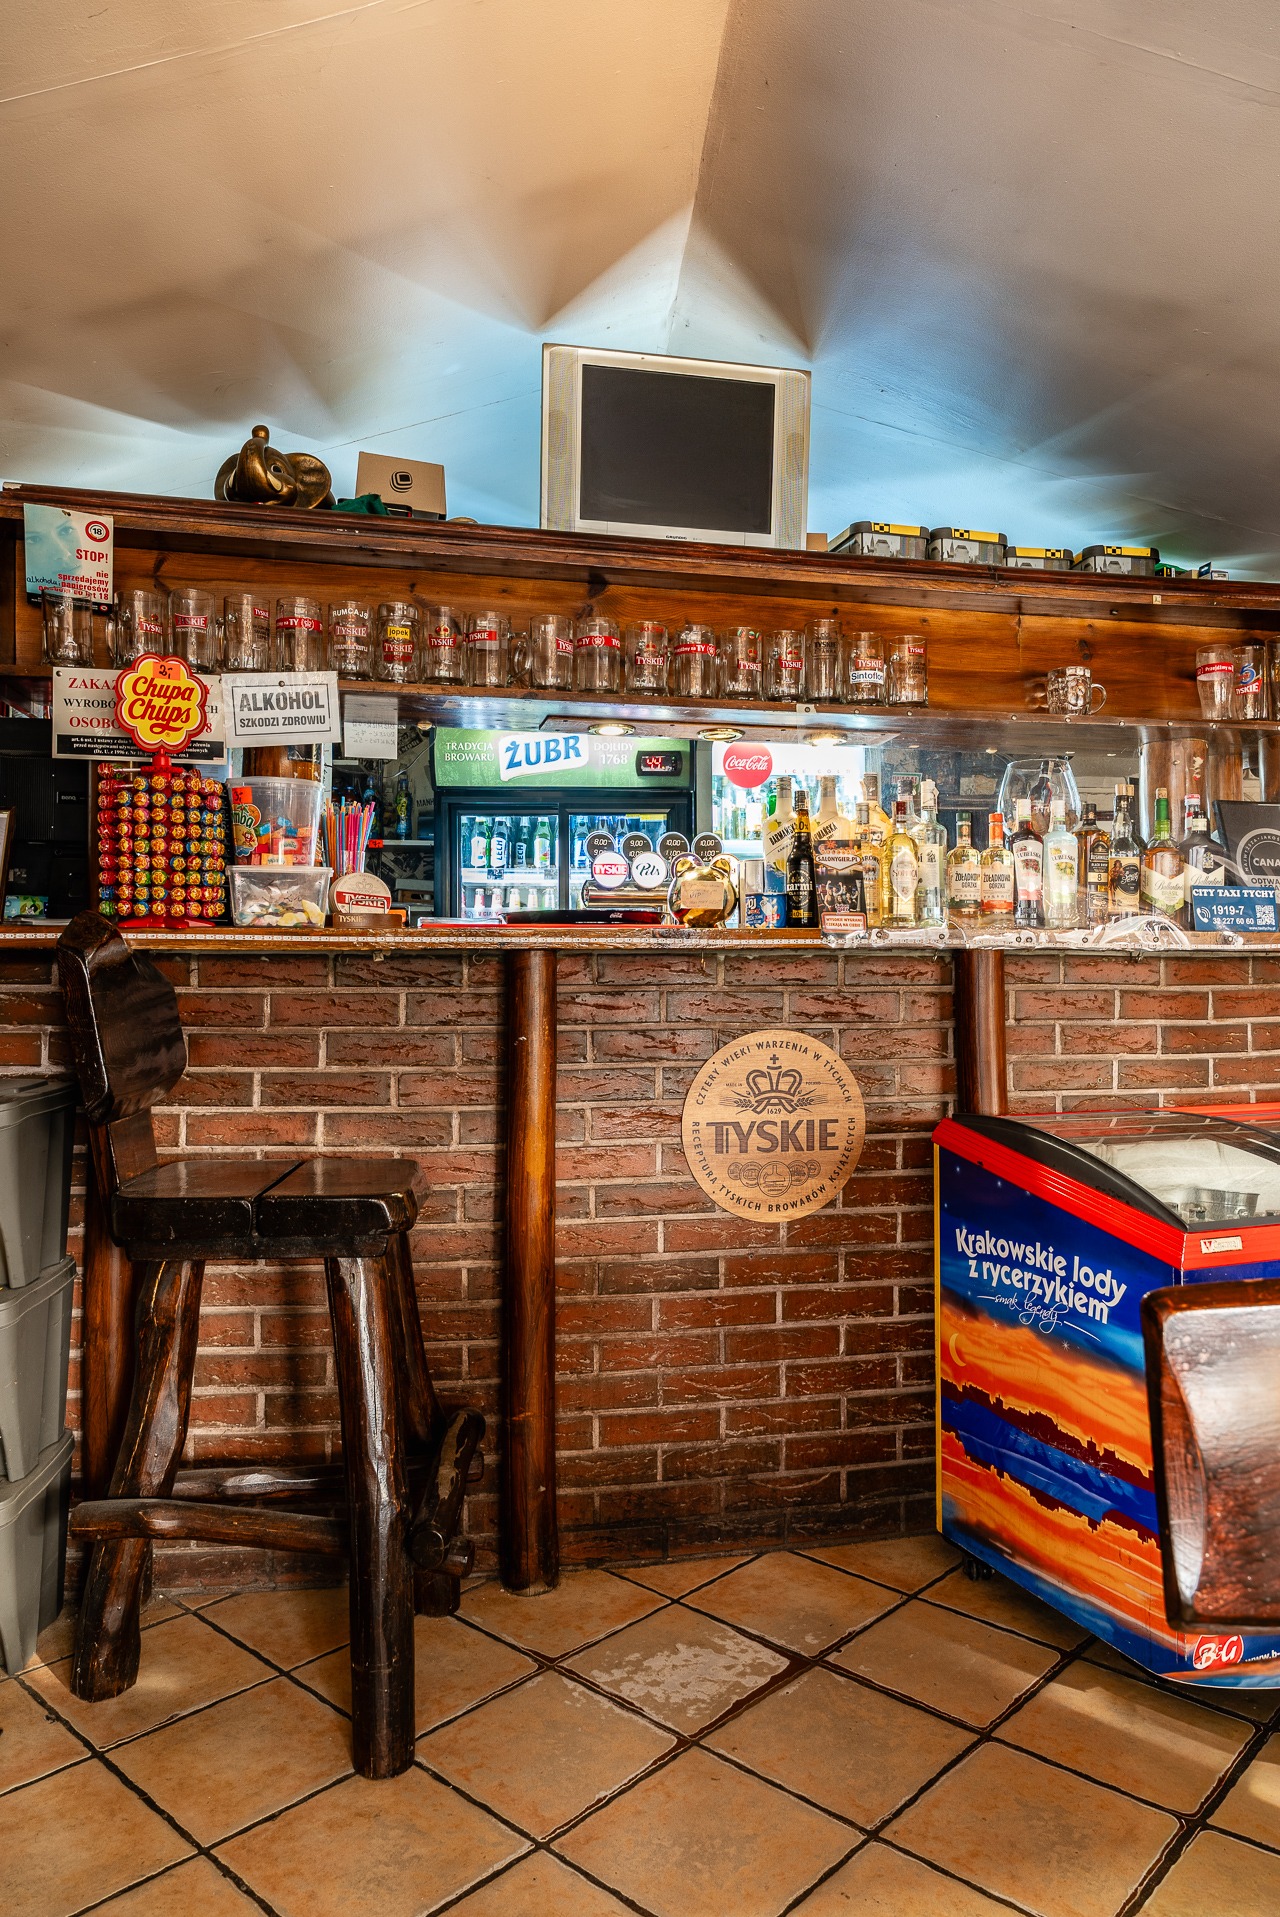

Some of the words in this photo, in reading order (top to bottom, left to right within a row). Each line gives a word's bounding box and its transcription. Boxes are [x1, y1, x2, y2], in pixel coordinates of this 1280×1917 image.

[76, 548, 109, 563] STOP!
[96, 570, 109, 579] nie
[99, 592, 109, 601] 18
[332, 608, 369, 620] RUMCAJS
[336, 626, 367, 637] TYSKIE
[469, 632, 489, 641] TYSKIE
[430, 638, 454, 646] TYSKIE
[384, 643, 413, 653] TYSKIE
[636, 656, 664, 666] TYSKIE
[739, 661, 762, 672] TYSKIE
[781, 661, 802, 669] TYSKIE
[858, 660, 882, 668] TYSKIE
[132, 676, 195, 705] Chupa
[1236, 682, 1260, 695] TYSKIE
[63, 698, 116, 709] WYROBÓ
[240, 691, 325, 712] ALKOHOL
[128, 698, 192, 734] Chups
[240, 717, 280, 728] SZKODZI
[282, 715, 326, 726] ZDROWIU
[69, 716, 121, 729] OSOBO
[446, 742, 494, 752] TRADYCJA
[505, 735, 582, 770] ŻUBR
[594, 742, 635, 753] DOJLIDY
[444, 753, 495, 762] BROWARU
[601, 754, 628, 765] 1768
[726, 756, 771, 771] Coca-Cola
[594, 864, 628, 875] TYSKIE
[636, 862, 660, 877] Pils
[1193, 889, 1216, 897] CITY
[1242, 890, 1275, 898] TYCHY
[342, 893, 385, 907] TYSKIE
[1212, 905, 1245, 915] 1919-7
[339, 915, 363, 923] TYSKIE
[696, 1066, 720, 1106] CZTERY
[721, 1046, 751, 1067] WIEKI
[756, 1040, 808, 1055] WARZENIA
[813, 1052, 823, 1062] W
[823, 1060, 852, 1103] TYCHACH
[706, 1119, 840, 1154] TYSKIE
[692, 1121, 718, 1185] RECEPTURA
[719, 1184, 762, 1212] TYSKICH
[768, 1184, 827, 1212] BROWARÓW
[829, 1117, 856, 1187] KSIĄŻĘCYCH
[956, 1228, 1068, 1275] Krakowskie
[1073, 1256, 1128, 1307] lody
[968, 1259, 980, 1278] z
[981, 1260, 1109, 1324] rycerzykiem
[995, 1292, 1022, 1310] smak
